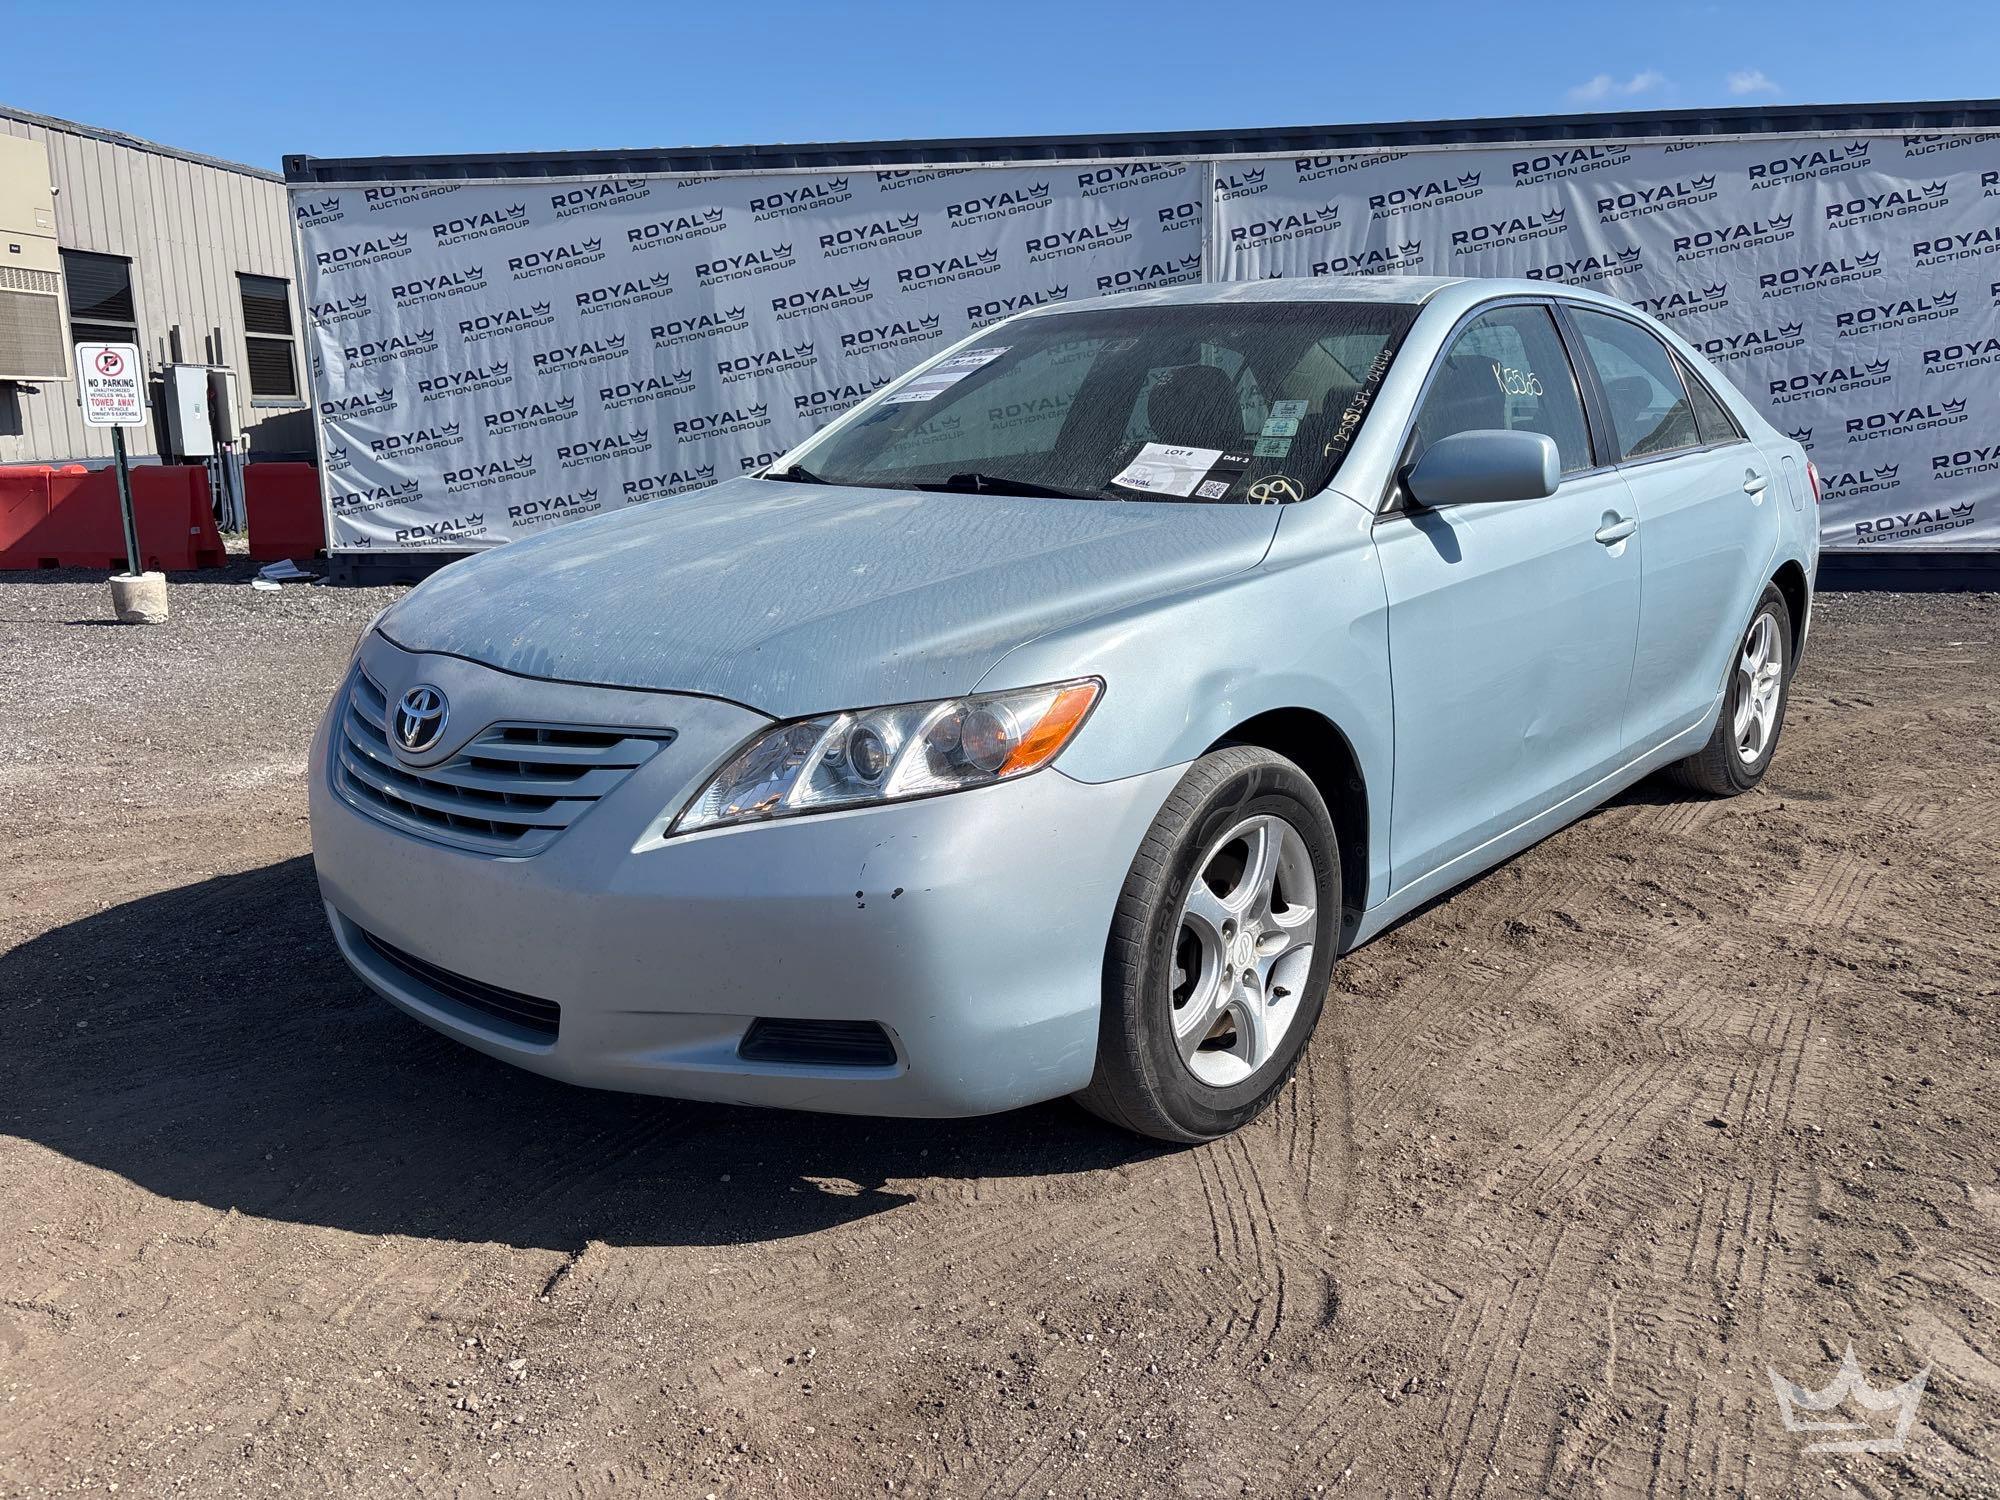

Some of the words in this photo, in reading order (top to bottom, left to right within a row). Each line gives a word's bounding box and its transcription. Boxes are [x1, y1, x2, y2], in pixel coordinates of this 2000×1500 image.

[1905, 137, 1970, 158] AUCTION
[1298, 159, 1353, 183] AUCTION
[1356, 152, 1409, 167] GROUP
[1512, 146, 1605, 177] ROYAL
[1515, 167, 1578, 187] AUCTION
[1581, 155, 1631, 172] GROUP
[1749, 149, 1844, 180] ROYAL
[1751, 170, 1816, 190] AUCTION
[1819, 159, 1871, 176] GROUP
[880, 175, 935, 193] AUCTION
[1078, 163, 1162, 188] ROYAL
[1083, 178, 1139, 197] AUCTION
[1142, 167, 1187, 183] GROUP
[372, 195, 419, 211] AUCTION
[421, 185, 459, 199] GROUP
[551, 181, 627, 209] ROYAL
[555, 200, 606, 218] AUCTION
[608, 190, 649, 205] GROUP
[750, 185, 829, 213] ROYAL
[947, 190, 1029, 219] ROYAL
[1221, 184, 1269, 201] GROUP
[1369, 179, 1458, 210] ROYAL
[1372, 200, 1432, 220] AUCTION
[1435, 189, 1483, 206] GROUP
[1597, 182, 1691, 213] ROYAL
[1826, 189, 1922, 219] ROYAL
[305, 213, 344, 227] GROUP
[754, 204, 806, 222] AUCTION
[809, 193, 851, 209] GROUP
[950, 210, 1005, 229] AUCTION
[1008, 199, 1052, 215] GROUP
[1600, 204, 1664, 224] AUCTION
[1667, 192, 1718, 209] GROUP
[1828, 210, 1894, 230] AUCTION
[1897, 199, 1949, 216] GROUP
[433, 210, 507, 238] ROYAL
[437, 230, 486, 248] AUCTION
[488, 220, 528, 235] GROUP
[627, 215, 705, 242] ROYAL
[819, 220, 900, 248] ROYAL
[1231, 213, 1316, 241] ROYAL
[1235, 233, 1292, 252] AUCTION
[1295, 221, 1342, 238] GROUP
[1452, 216, 1542, 246] ROYAL
[1673, 221, 1768, 252] ROYAL
[317, 239, 390, 265] ROYAL
[1026, 225, 1108, 253] ROYAL
[1029, 245, 1085, 263] AUCTION
[1087, 234, 1132, 250] GROUP
[1455, 236, 1516, 256] AUCTION
[1519, 225, 1567, 242] GROUP
[1676, 243, 1740, 262] AUCTION
[1743, 231, 1794, 248] GROUP
[322, 258, 371, 274] AUCTION
[372, 248, 411, 262] GROUP
[508, 244, 584, 271] ROYAL
[695, 250, 773, 278] ROYAL
[897, 255, 978, 283] ROYAL
[1312, 247, 1399, 277] ROYAL
[1377, 256, 1424, 273] GROUP
[1526, 254, 1617, 281] ROYAL
[1916, 248, 1981, 267] AUCTION
[392, 272, 466, 299] ROYAL
[1097, 261, 1180, 290] ROYAL
[1593, 264, 1643, 280] GROUP
[1759, 258, 1855, 289] ROYAL
[1762, 279, 1827, 299] AUCTION
[1830, 268, 1882, 285] GROUP
[397, 291, 446, 308] AUCTION
[448, 281, 487, 296] GROUP
[576, 279, 651, 307] ROYAL
[772, 284, 851, 312] ROYAL
[967, 292, 1048, 319] ROYAL
[333, 309, 371, 323] GROUP
[459, 308, 533, 334] ROYAL
[1678, 300, 1728, 316] GROUP
[1836, 298, 1932, 327] ROYAL
[650, 313, 726, 339] ROYAL
[655, 331, 706, 349] AUCTION
[708, 322, 748, 336] GROUP
[841, 321, 920, 348] ROYAL
[1839, 319, 1904, 338] AUCTION
[1907, 308, 1959, 324] GROUP
[344, 335, 417, 360] ROYAL
[533, 341, 607, 367] ROYAL
[845, 340, 898, 357] AUCTION
[900, 330, 943, 345] GROUP
[1753, 338, 1805, 355] GROUP
[717, 348, 795, 375] ROYAL
[1926, 356, 1991, 375] AUCTION
[88, 379, 98, 387] NO
[102, 379, 134, 387] PARKING
[418, 368, 491, 393] ROYAL
[423, 386, 472, 402] AUCTION
[473, 376, 512, 391] GROUP
[599, 375, 674, 401] ROYAL
[1769, 366, 1865, 395] ROYAL
[1772, 386, 1837, 405] AUCTION
[1840, 375, 1891, 391] GROUP
[91, 399, 114, 407] TOWED
[118, 399, 134, 407] AWAY
[360, 402, 398, 416] GROUP
[794, 383, 871, 409] ROYAL
[484, 402, 557, 427] ROYAL
[673, 409, 749, 435] ROYAL
[1846, 405, 1942, 433] ROYAL
[370, 428, 443, 453] ROYAL
[678, 427, 728, 444] AUCTION
[730, 418, 771, 432] GROUP
[1849, 425, 1914, 443] AUCTION
[1917, 414, 1969, 430] GROUP
[557, 435, 630, 460] ROYAL
[443, 460, 515, 485] ROYAL
[448, 478, 496, 493] AUCTION
[498, 469, 536, 482] GROUP
[622, 470, 697, 494] ROYAL
[1933, 462, 1998, 480] AUCTION
[330, 485, 403, 509] ROYAL
[628, 487, 677, 503] AUCTION
[679, 479, 719, 492] GROUP
[1849, 480, 1901, 496] GROUP
[508, 494, 580, 518] ROYAL
[394, 518, 467, 542] ROYAL
[449, 527, 488, 540] GROUP
[1855, 509, 1949, 535] ROYAL
[1856, 528, 1920, 545] AUCTION
[1923, 518, 1974, 533] GROUP
